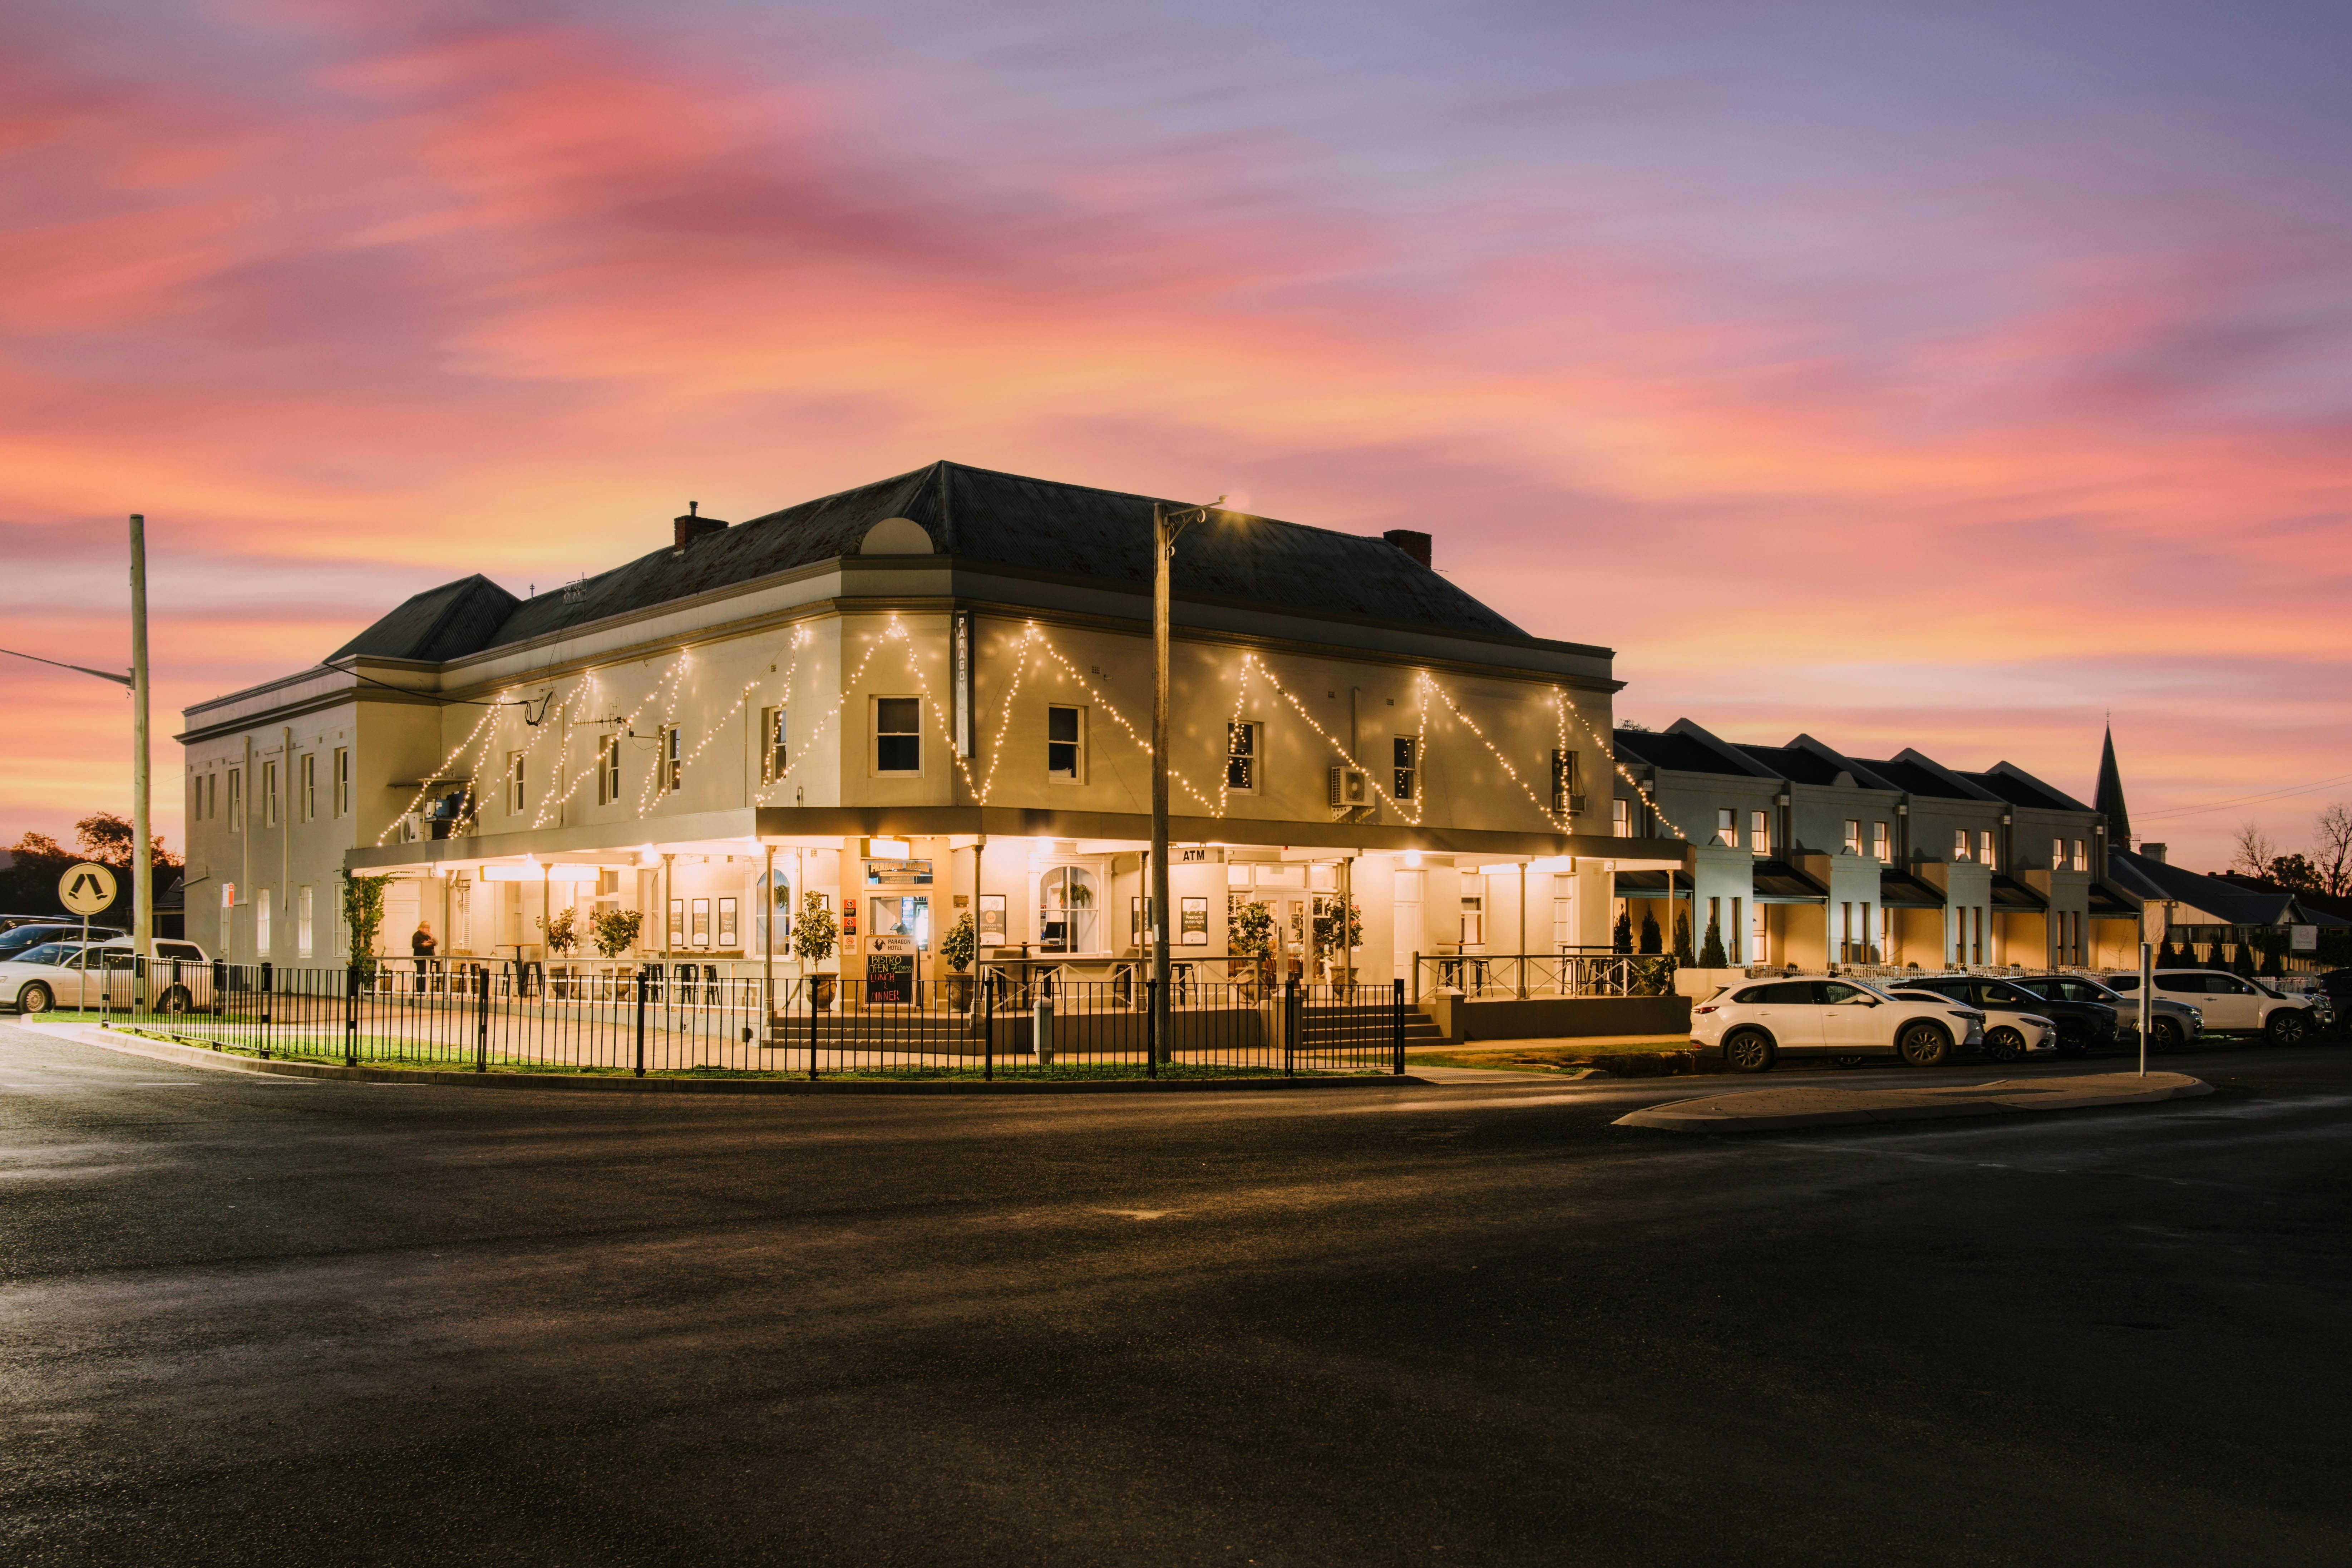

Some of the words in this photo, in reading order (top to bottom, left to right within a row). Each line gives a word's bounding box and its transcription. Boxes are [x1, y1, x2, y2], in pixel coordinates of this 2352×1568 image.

[1183, 849, 1204, 861] ATM
[871, 862, 903, 873] PARAGON
[906, 862, 929, 873] HOTEL
[871, 956, 902, 964] BISTRO
[869, 964, 888, 973] OPEN
[891, 964, 897, 973] 7
[870, 973, 895, 982] LUNCH
[871, 990, 899, 1001] DINNER
